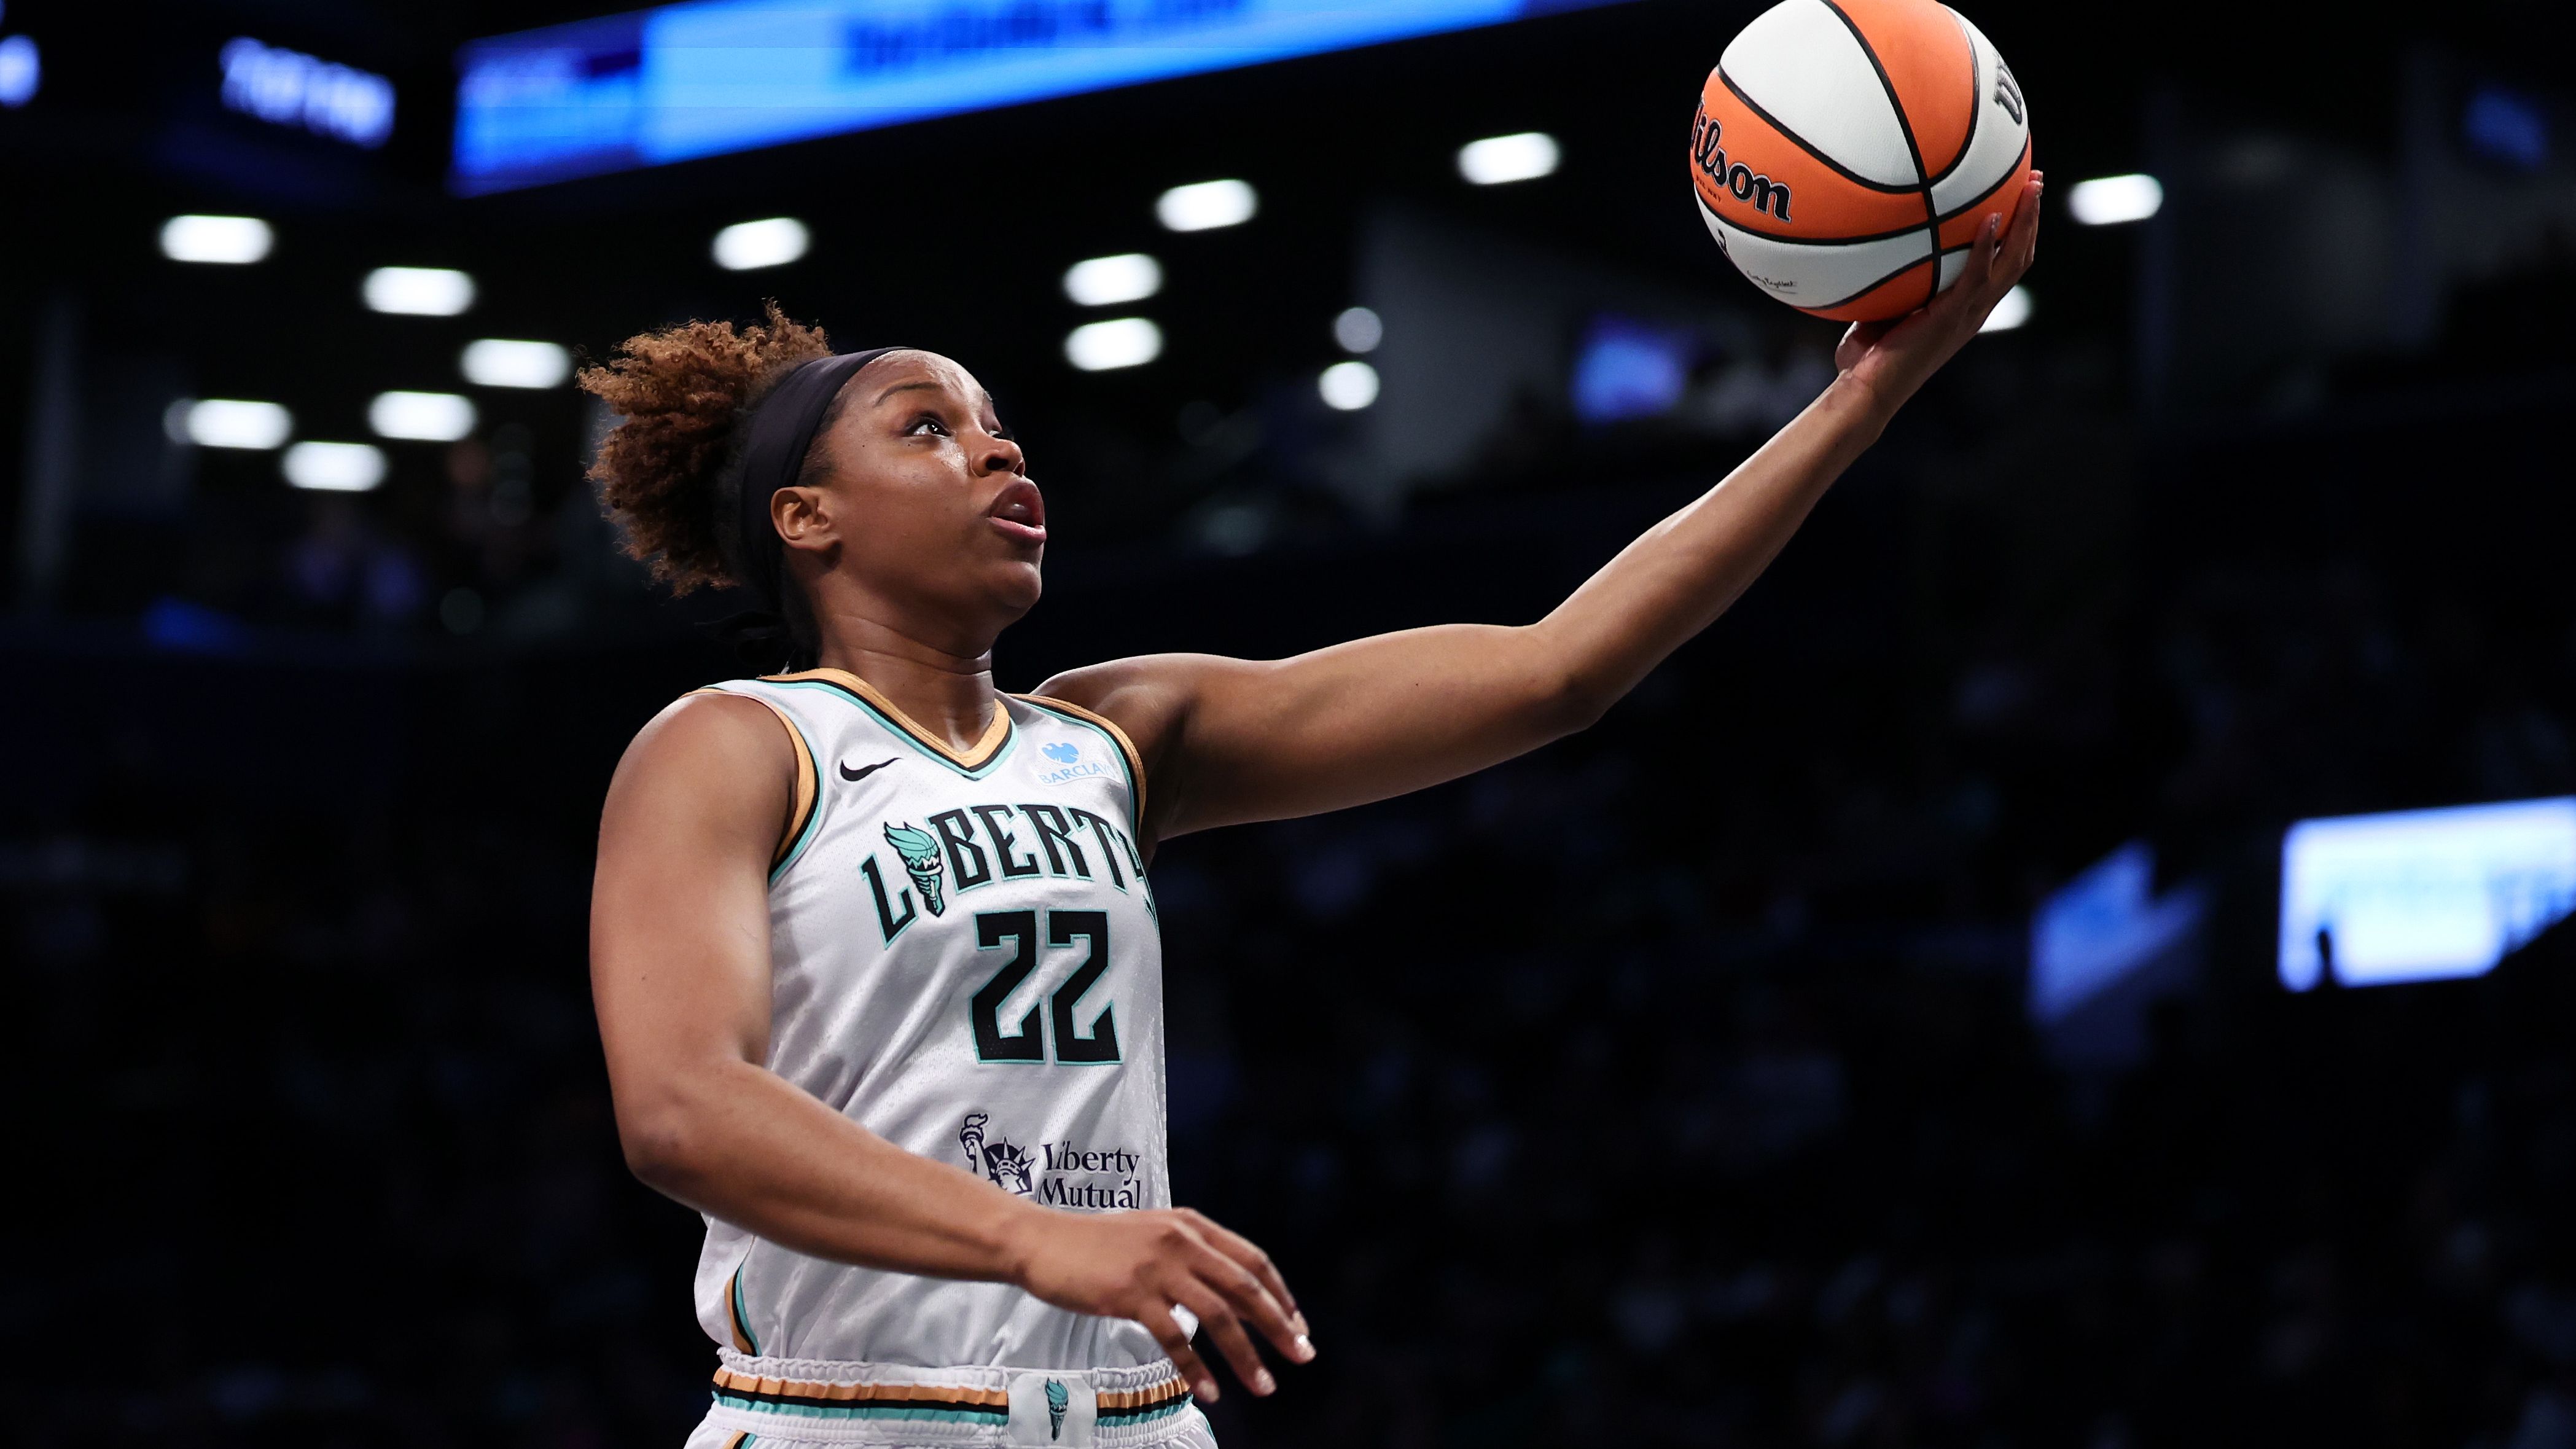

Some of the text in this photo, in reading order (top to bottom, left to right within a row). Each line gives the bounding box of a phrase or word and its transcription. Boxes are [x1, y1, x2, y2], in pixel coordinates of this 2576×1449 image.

[968, 908, 1123, 1066] 22
[1040, 1140, 1141, 1185] Liberty
[1037, 1177, 1141, 1210] Mutual
